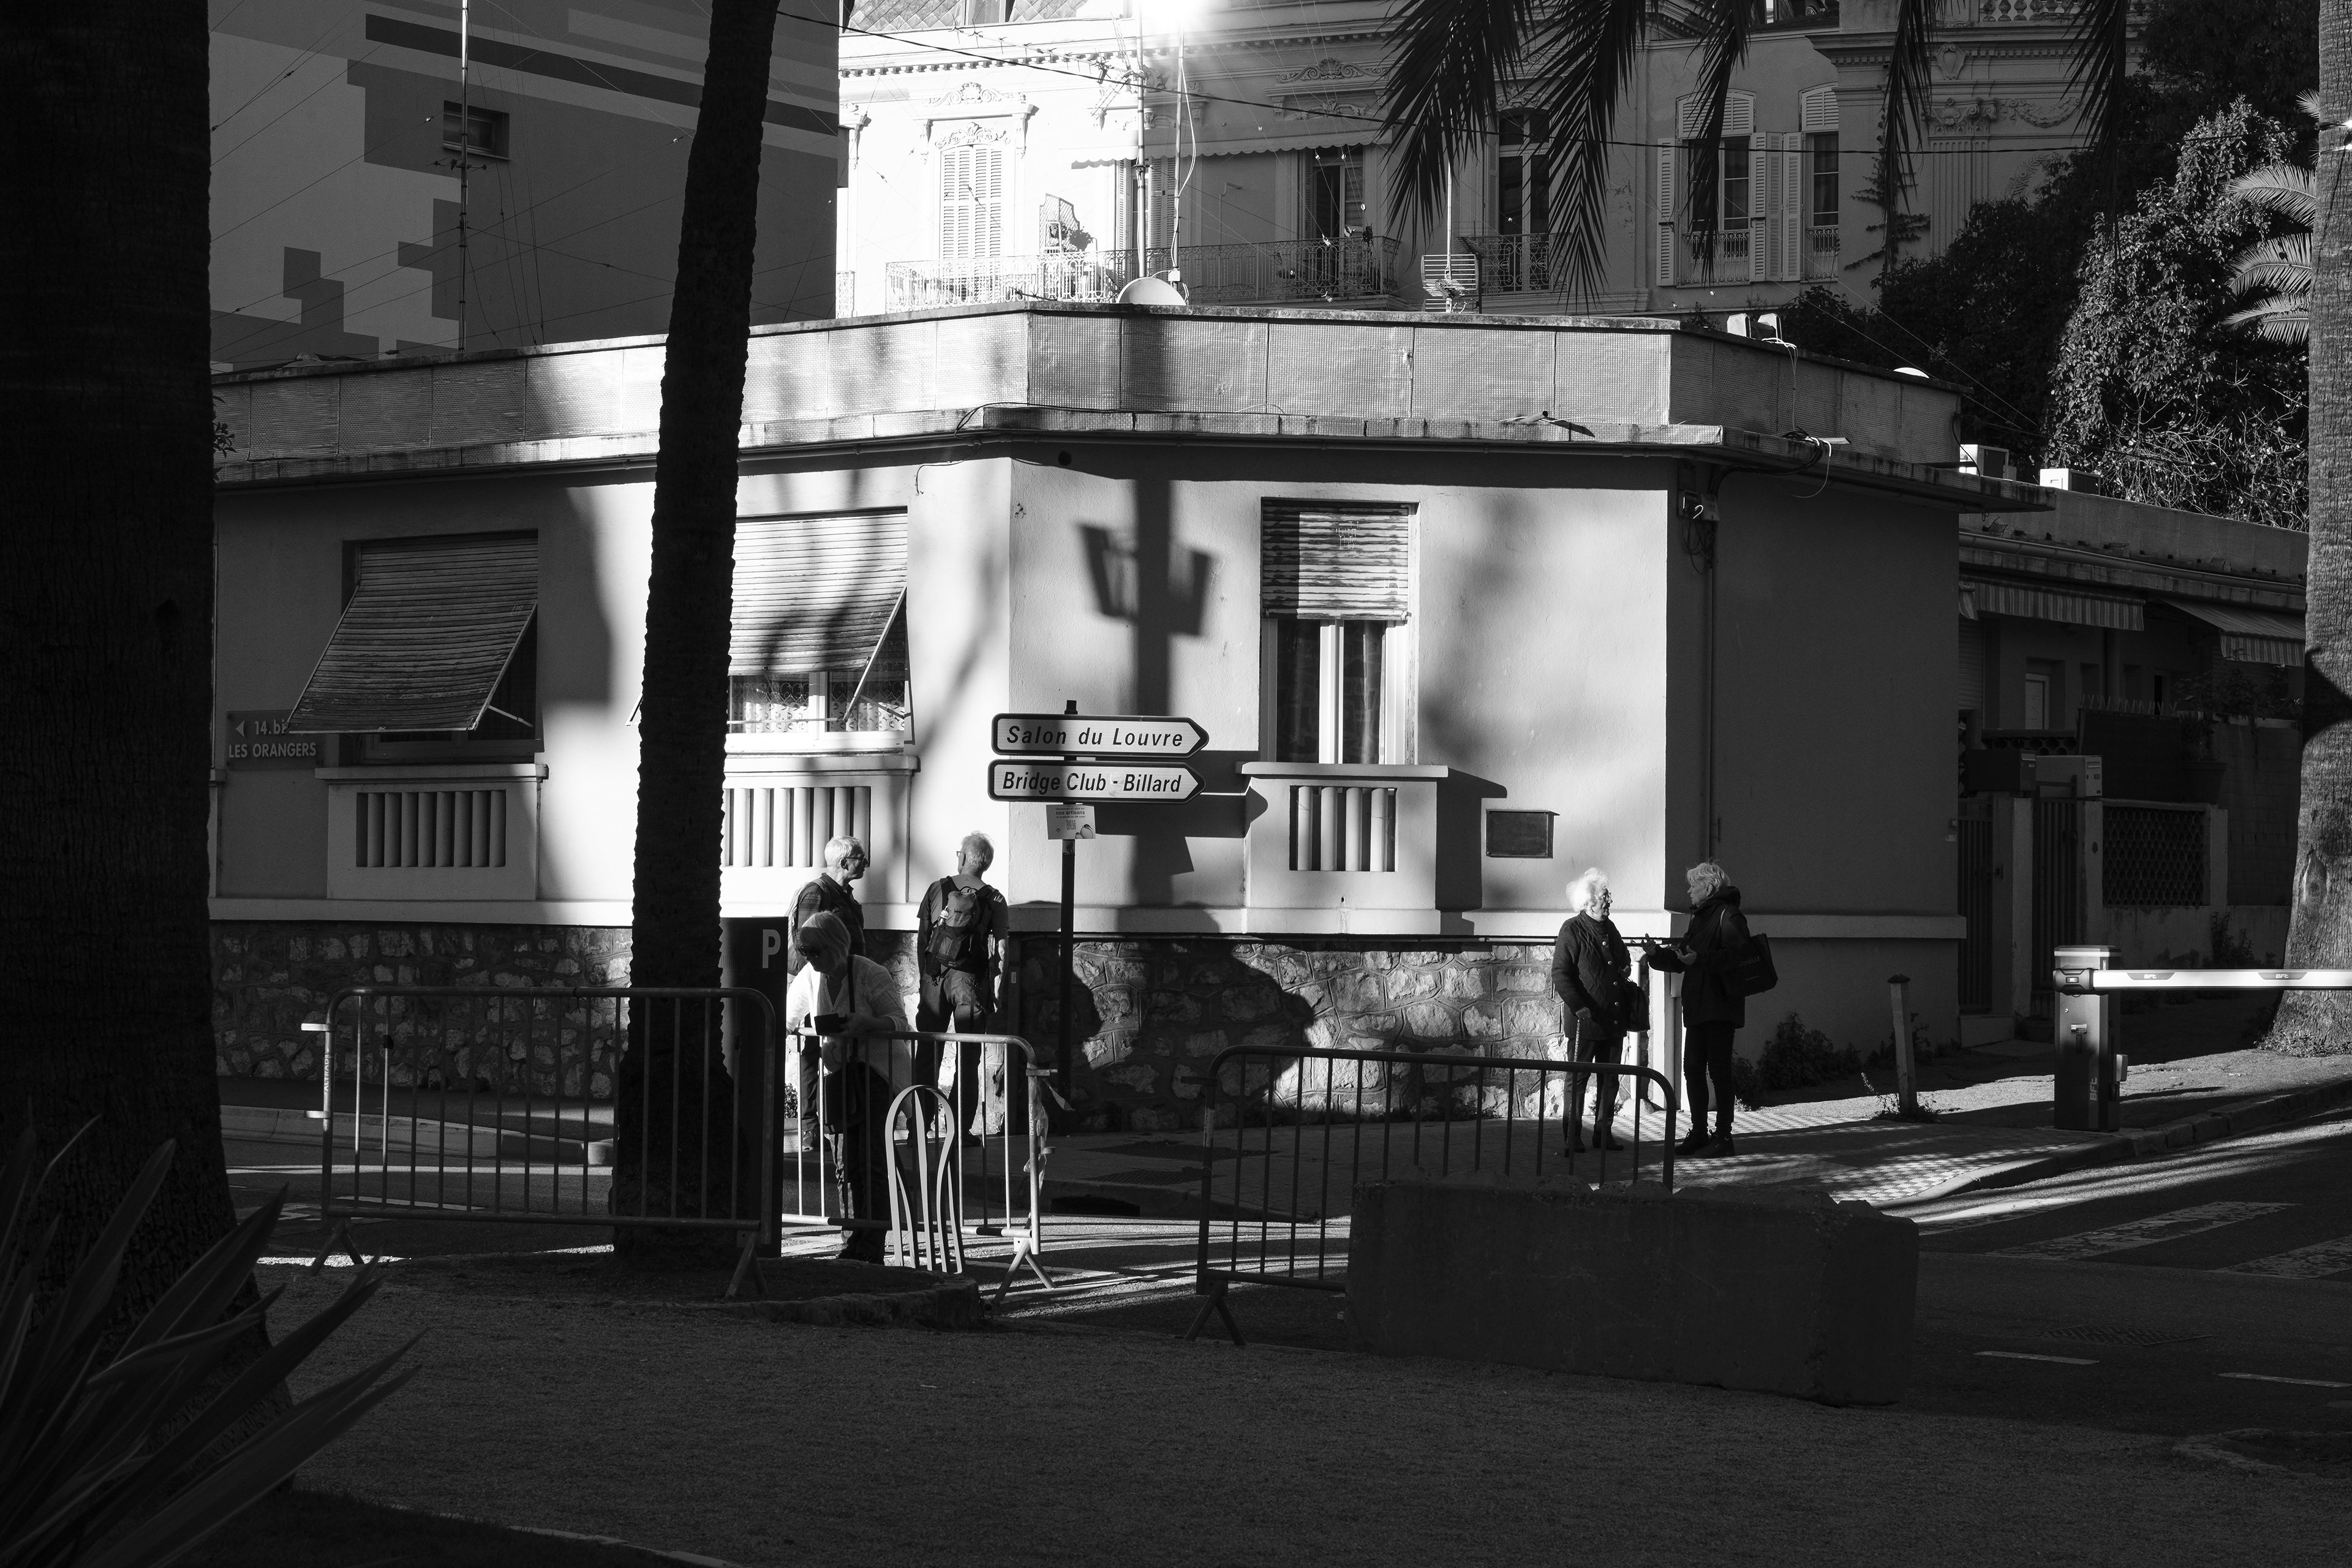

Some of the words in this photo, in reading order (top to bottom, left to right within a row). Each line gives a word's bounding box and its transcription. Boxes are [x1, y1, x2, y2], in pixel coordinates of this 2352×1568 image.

[255, 719, 285, 734] 14.bi
[1006, 725, 1066, 744] Salon
[1079, 727, 1102, 745] du
[1113, 728, 1183, 747] Louvre
[228, 743, 248, 758] LES
[252, 742, 317, 758] ORANGERS
[1003, 772, 1060, 794] Bridge
[1066, 773, 1106, 791] Club
[1123, 774, 1182, 793] Billard
[762, 929, 781, 969] P
